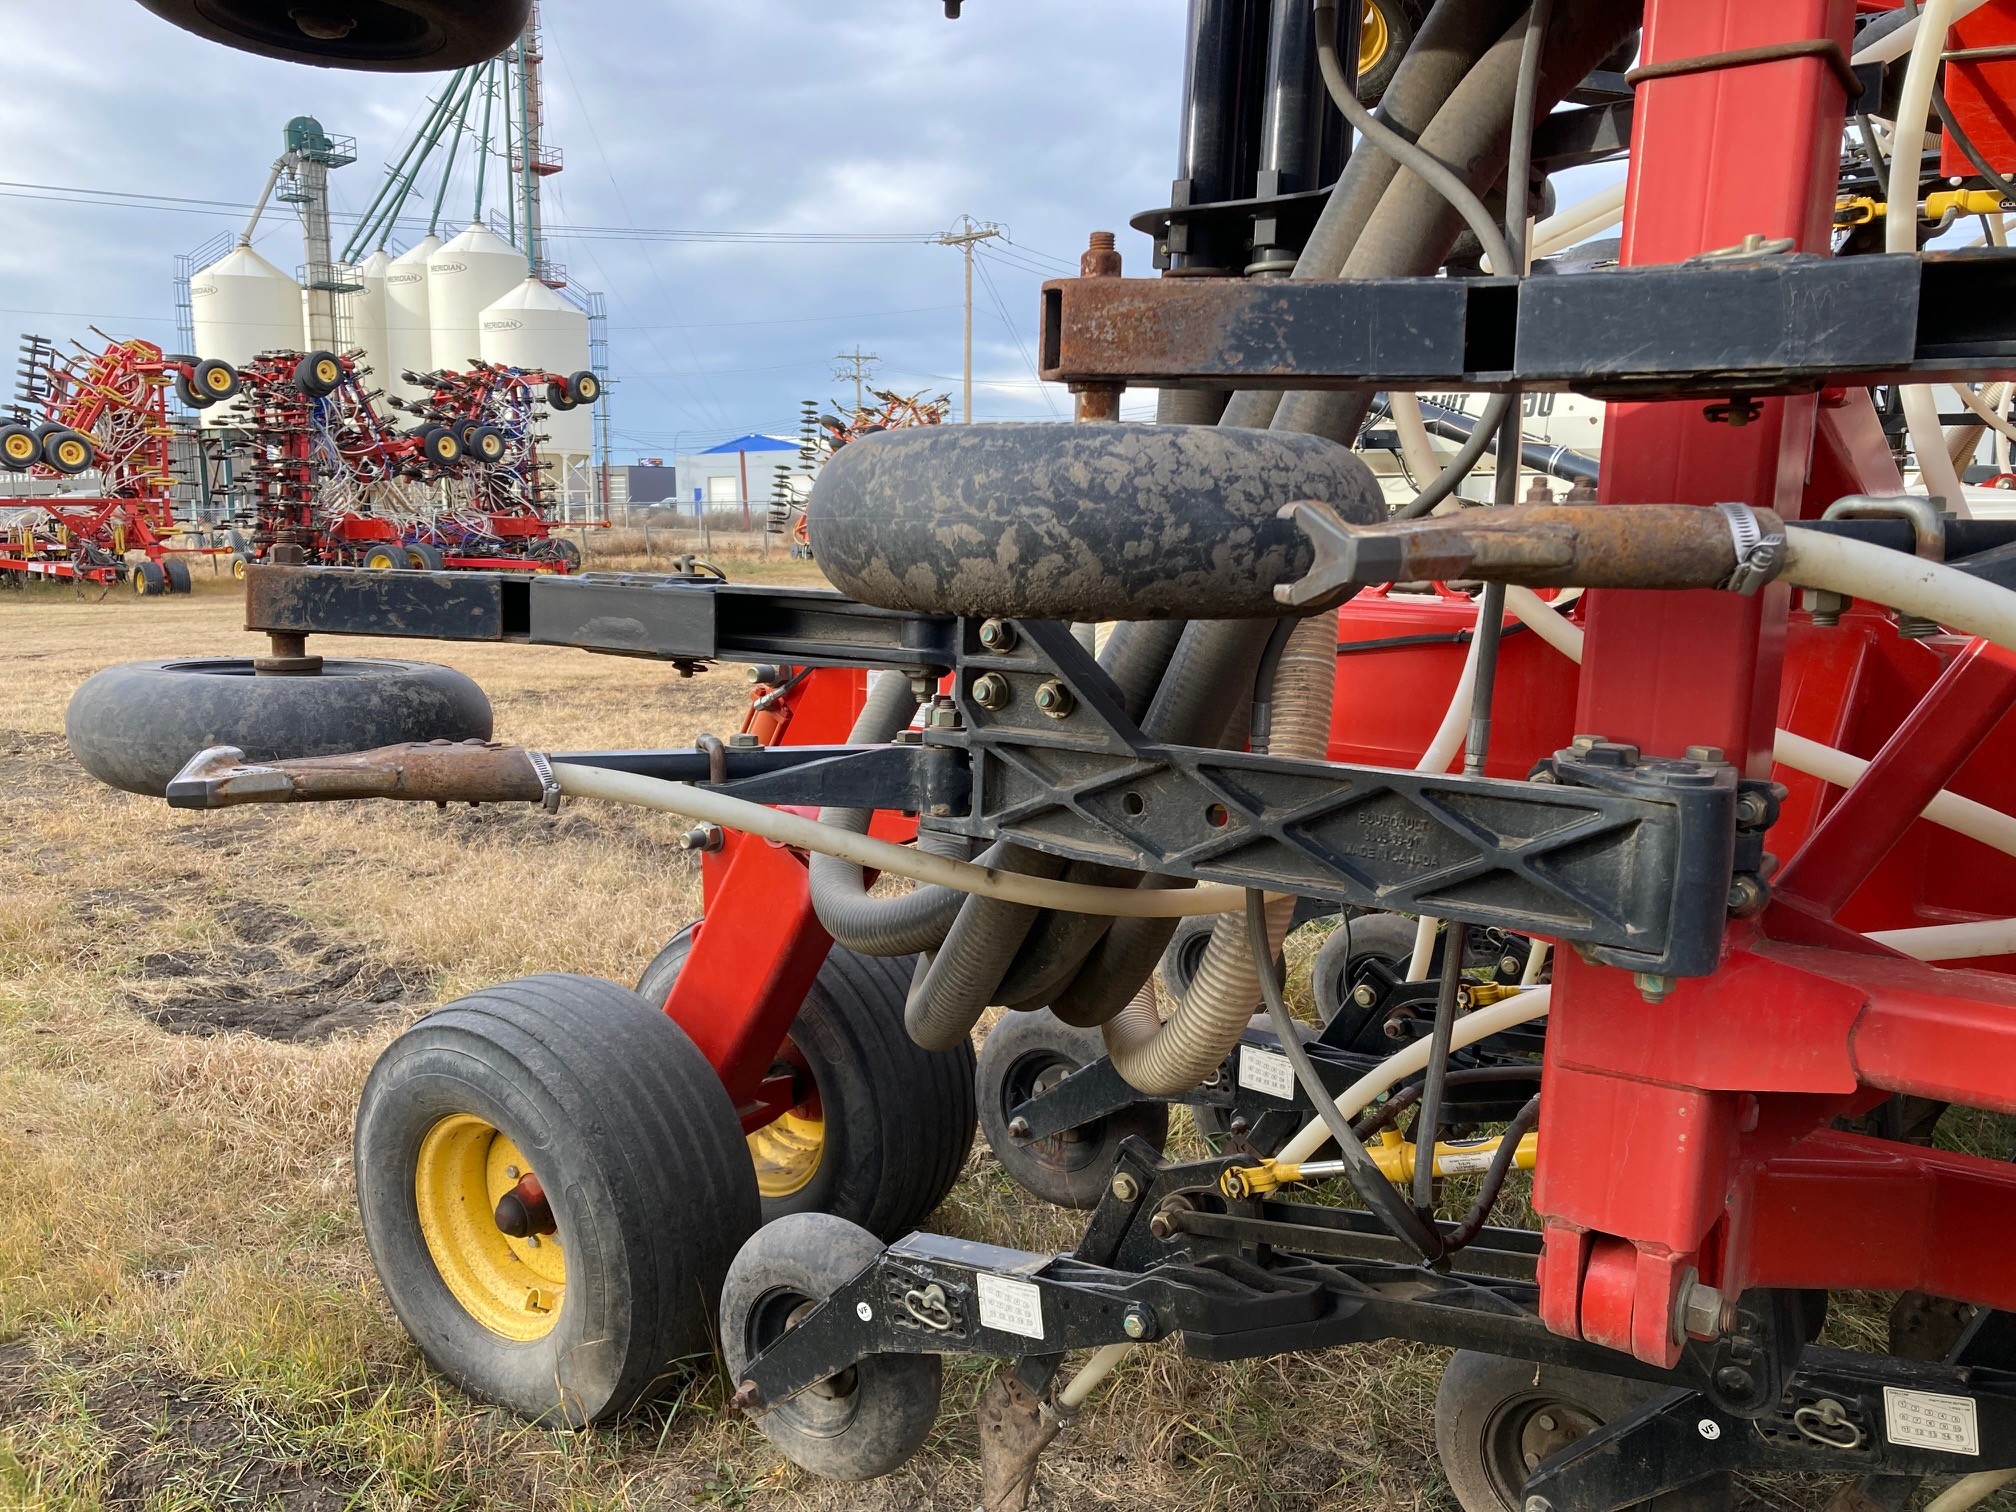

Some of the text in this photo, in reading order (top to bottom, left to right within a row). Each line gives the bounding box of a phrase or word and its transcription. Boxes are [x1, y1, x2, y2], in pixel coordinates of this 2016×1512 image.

[431, 264, 462, 272] MERIDIAN
[387, 274, 417, 283] MERIDIAN
[484, 321, 517, 329] MERIDIAN
[1358, 812, 1429, 830] BOURGAULT
[1343, 843, 1438, 867] MADE IN CANADA
[858, 1306, 868, 1315] VF
[1701, 1424, 1714, 1434] VF
